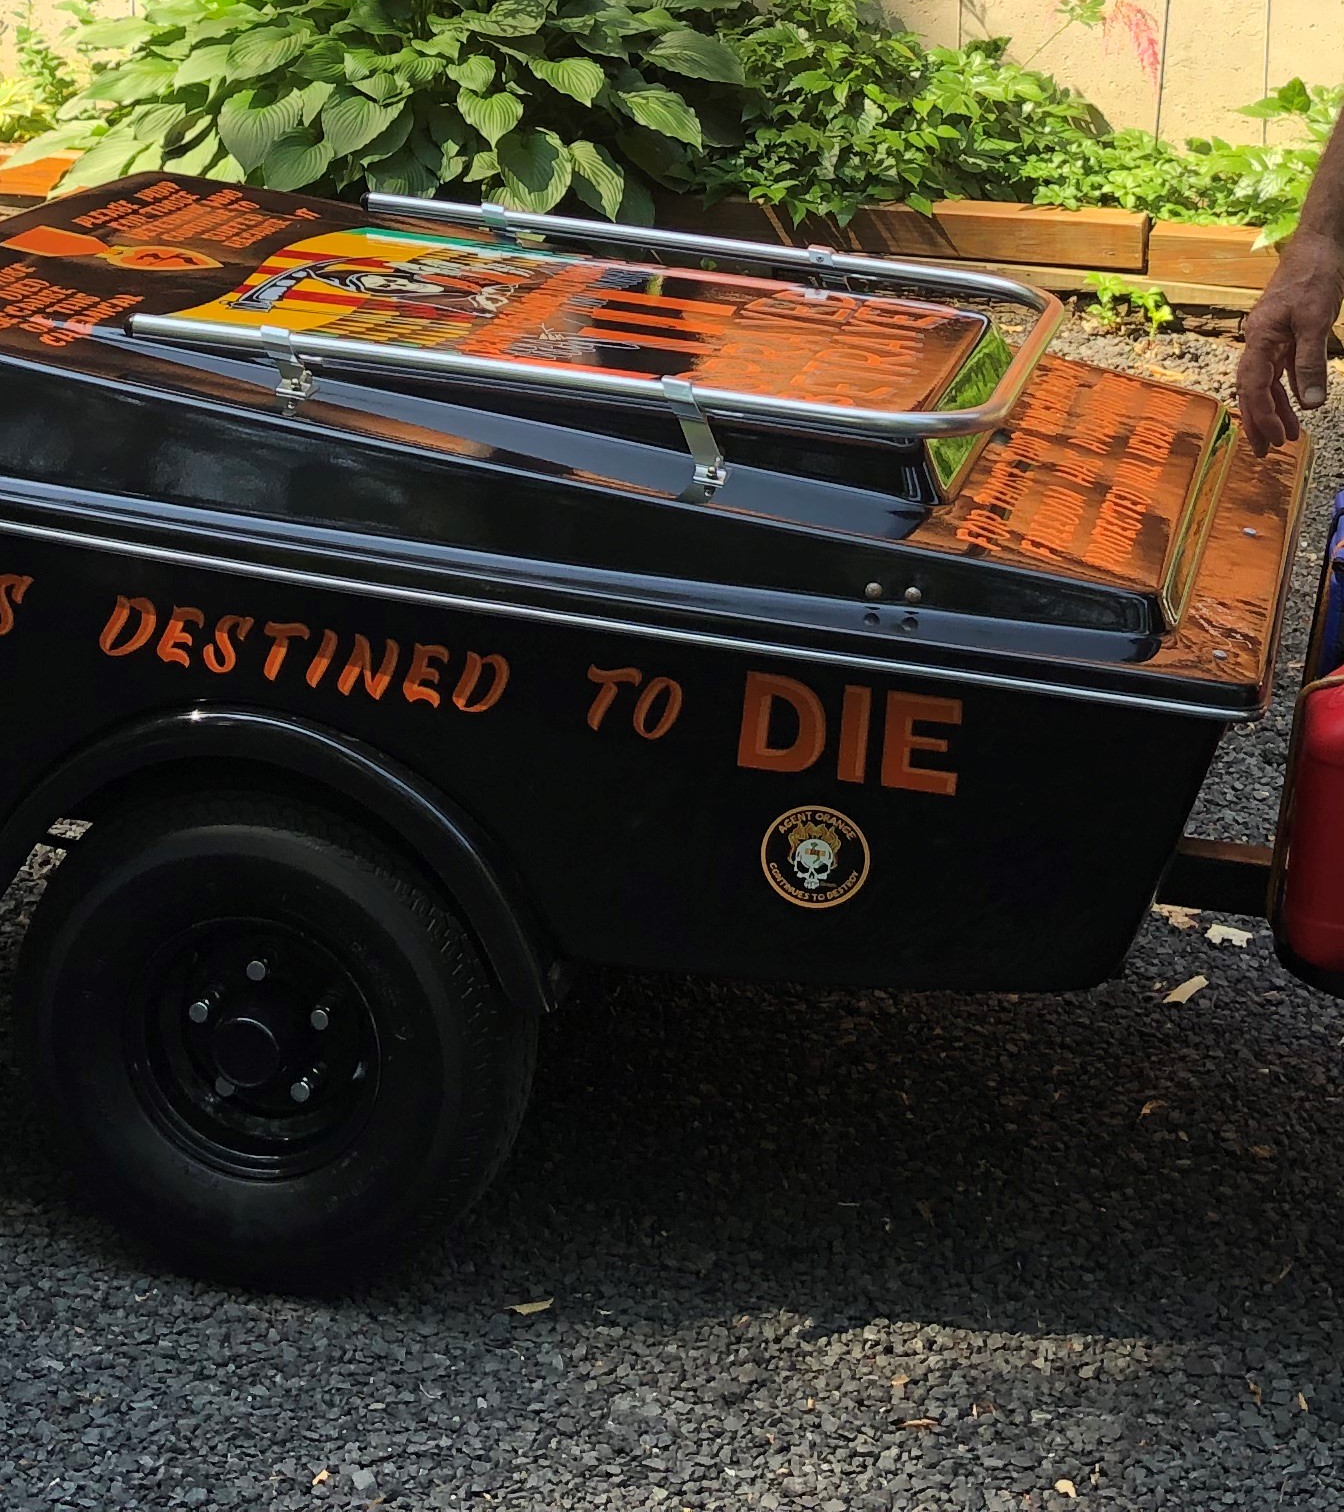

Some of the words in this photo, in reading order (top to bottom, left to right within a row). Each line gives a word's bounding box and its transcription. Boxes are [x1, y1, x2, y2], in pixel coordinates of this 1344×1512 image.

[18, 314, 54, 332] OF
[46, 292, 100, 314] THIS
[973, 463, 1034, 509] THOSE
[956, 509, 1010, 551] FOR
[1085, 486, 1152, 571] PROTECTED
[99, 594, 509, 712] DESTINED
[587, 664, 683, 740] TO
[737, 671, 963, 795] DIE
[778, 811, 812, 833] AGENT
[815, 812, 857, 840] ORANGE
[769, 862, 809, 899] CONTINUES
[812, 893, 825, 901] TO
[826, 870, 859, 900] DESTROY
